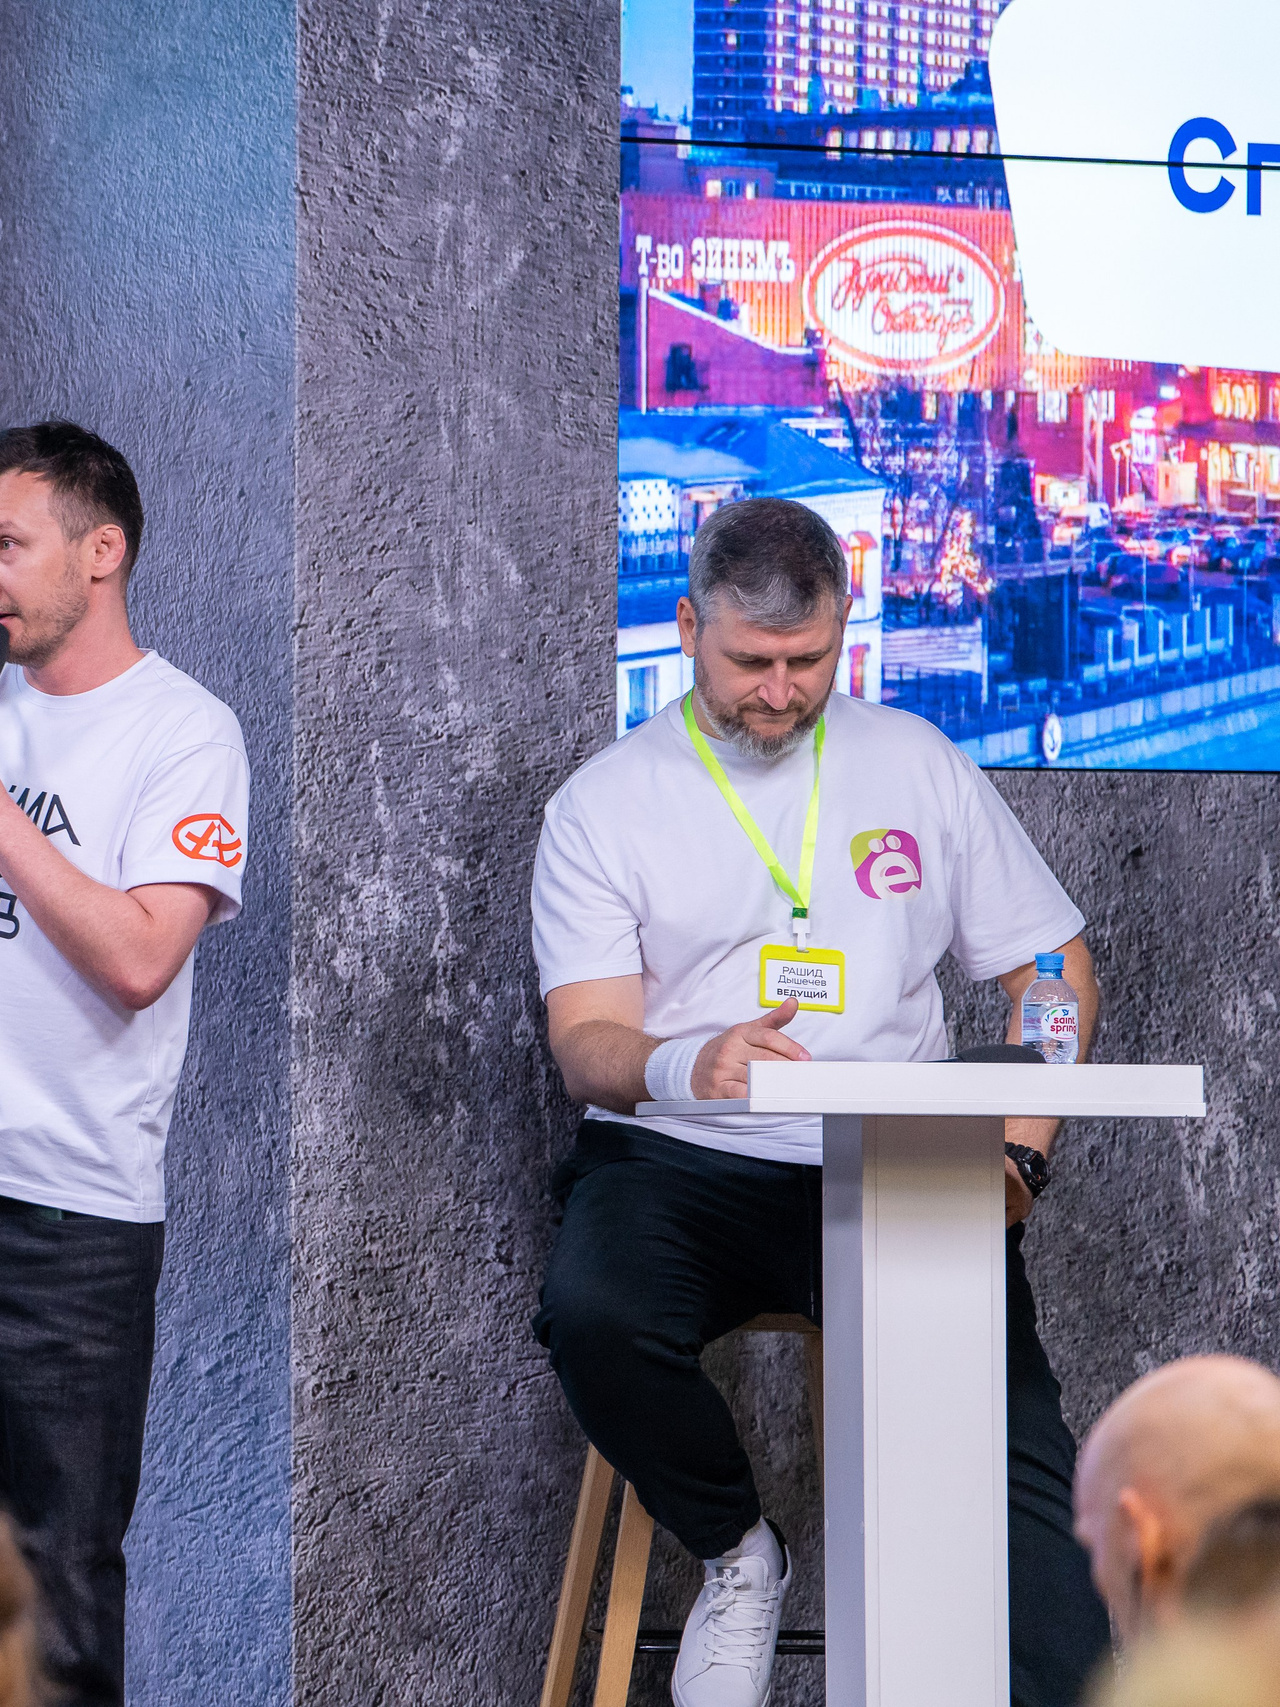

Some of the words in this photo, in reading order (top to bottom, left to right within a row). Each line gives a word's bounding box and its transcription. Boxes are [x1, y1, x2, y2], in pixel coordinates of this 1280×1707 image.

[782, 966, 824, 978] РАШИД
[776, 988, 828, 999] ВЕДУЩИЙ
[1053, 1016, 1075, 1025] saint
